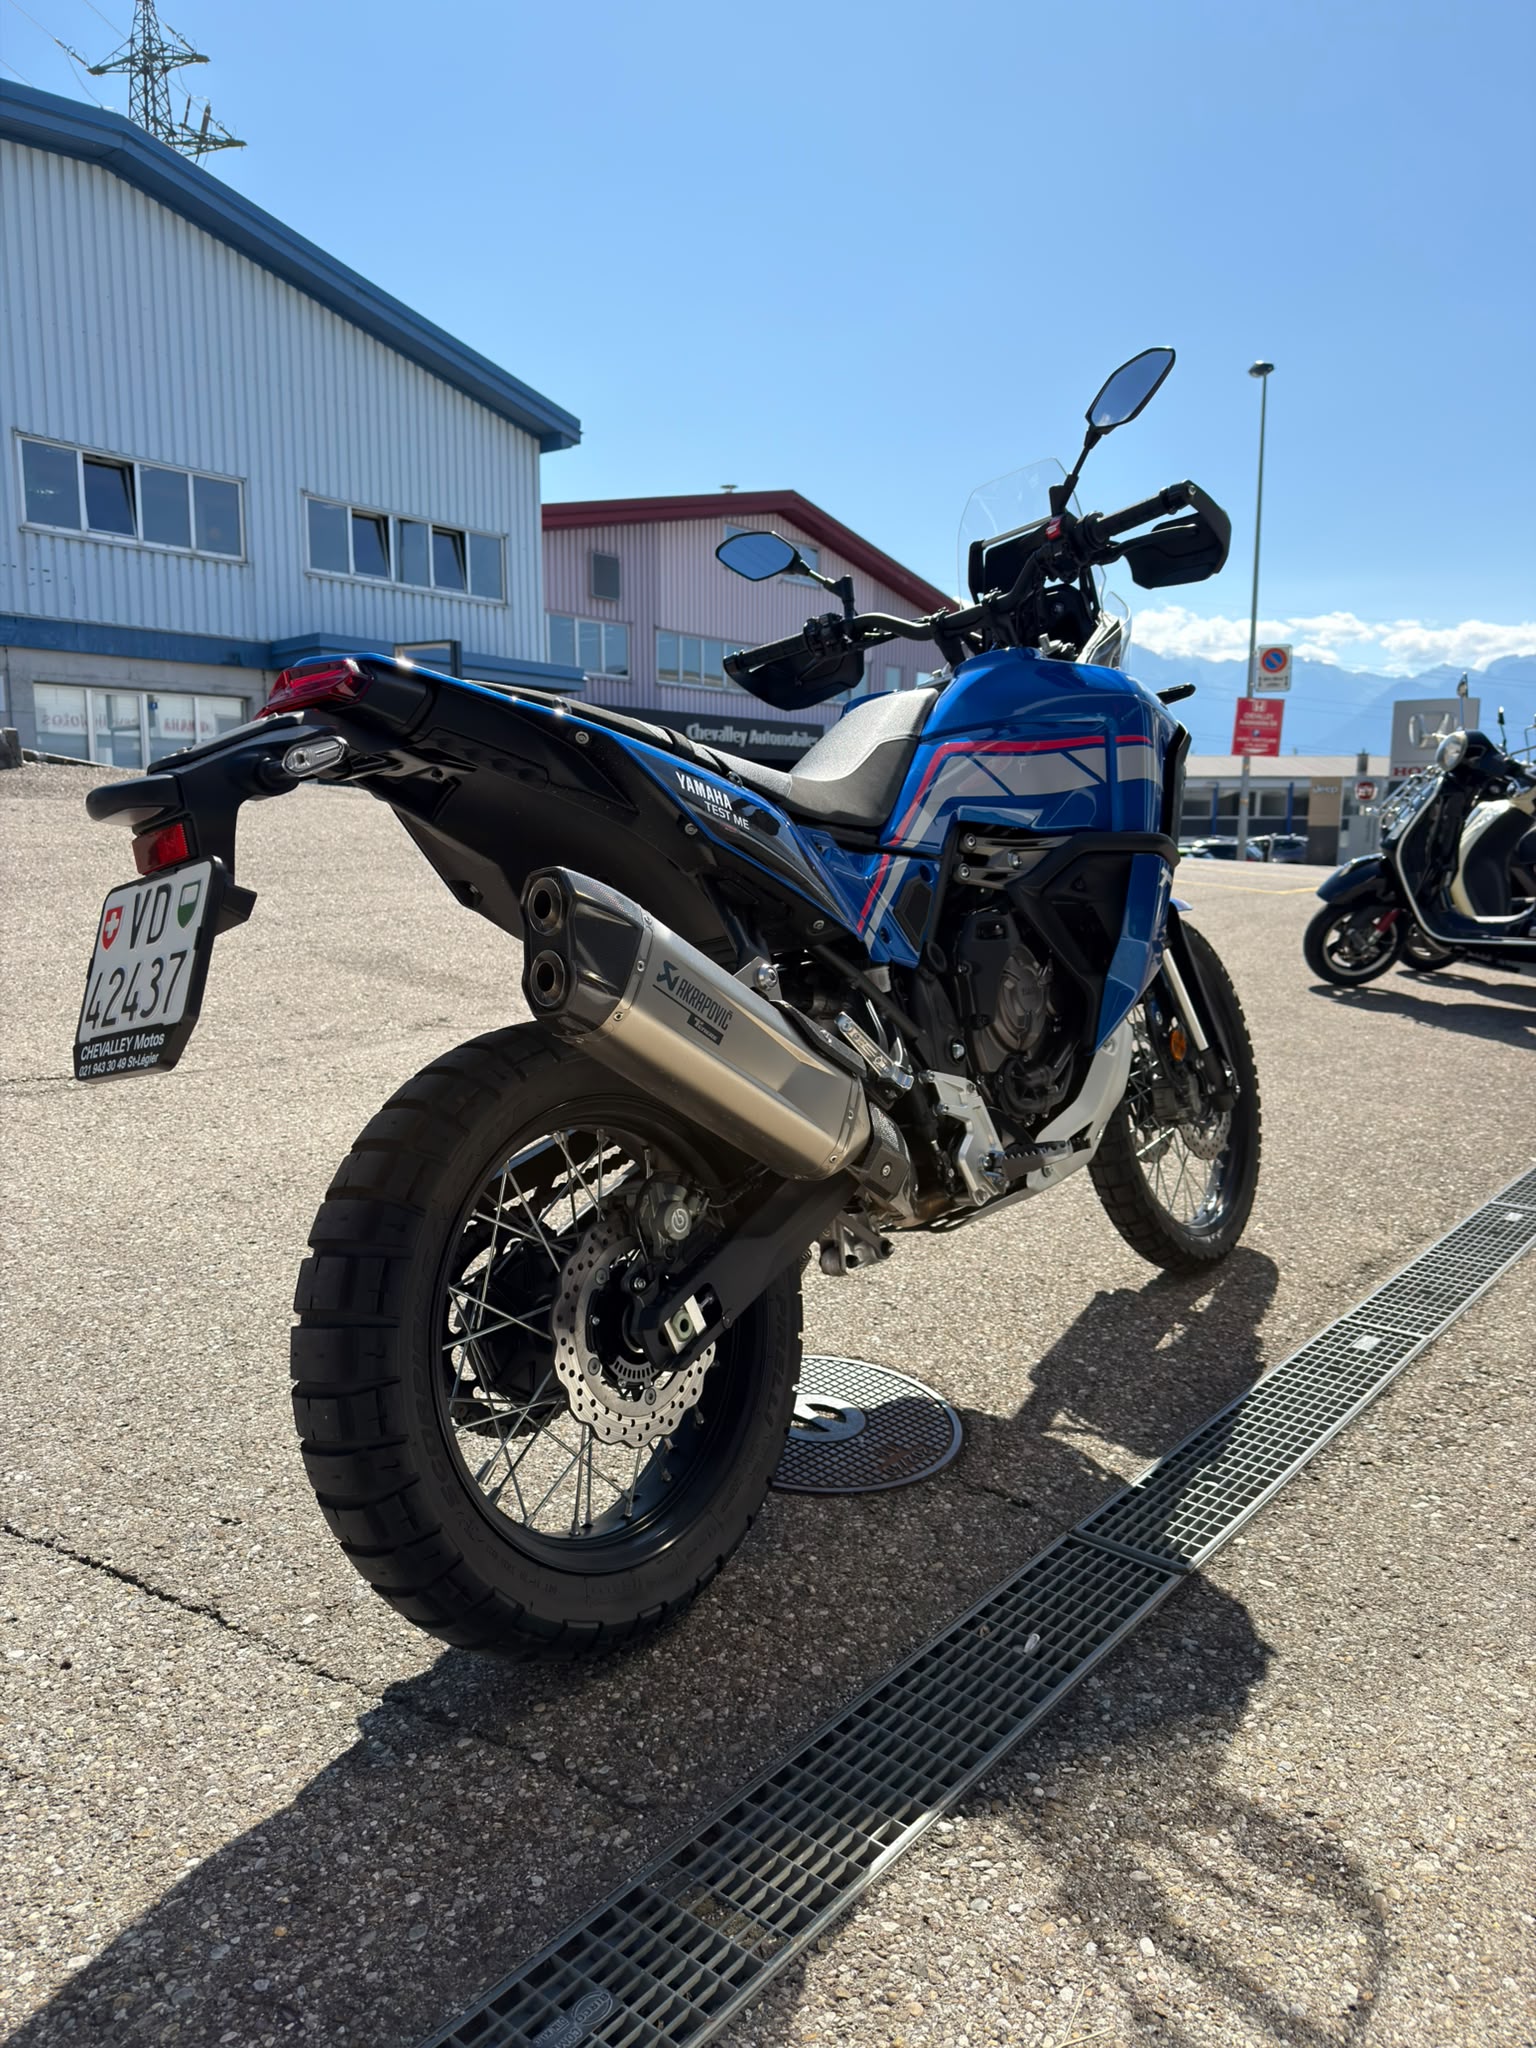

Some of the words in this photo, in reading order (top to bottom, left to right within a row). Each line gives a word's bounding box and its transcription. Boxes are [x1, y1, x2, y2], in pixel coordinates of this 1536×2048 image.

[686, 723, 748, 747] Chevalley
[675, 771, 733, 811] YAMAHA
[704, 800, 731, 821] TEST
[733, 813, 750, 830] ME
[129, 883, 172, 950] VD
[84, 950, 188, 1030] 42437
[676, 978, 734, 1031] AKRAPOVIČ
[80, 1035, 134, 1061] CHEVALLEY
[134, 1032, 165, 1051] Motos
[79, 1064, 92, 1077] 021
[92, 1061, 105, 1075] 943
[106, 1059, 116, 1072] 30
[117, 1057, 127, 1070] 49
[127, 1051, 159, 1068] St-Légier
[575, 1992, 610, 2024] BIRCO
